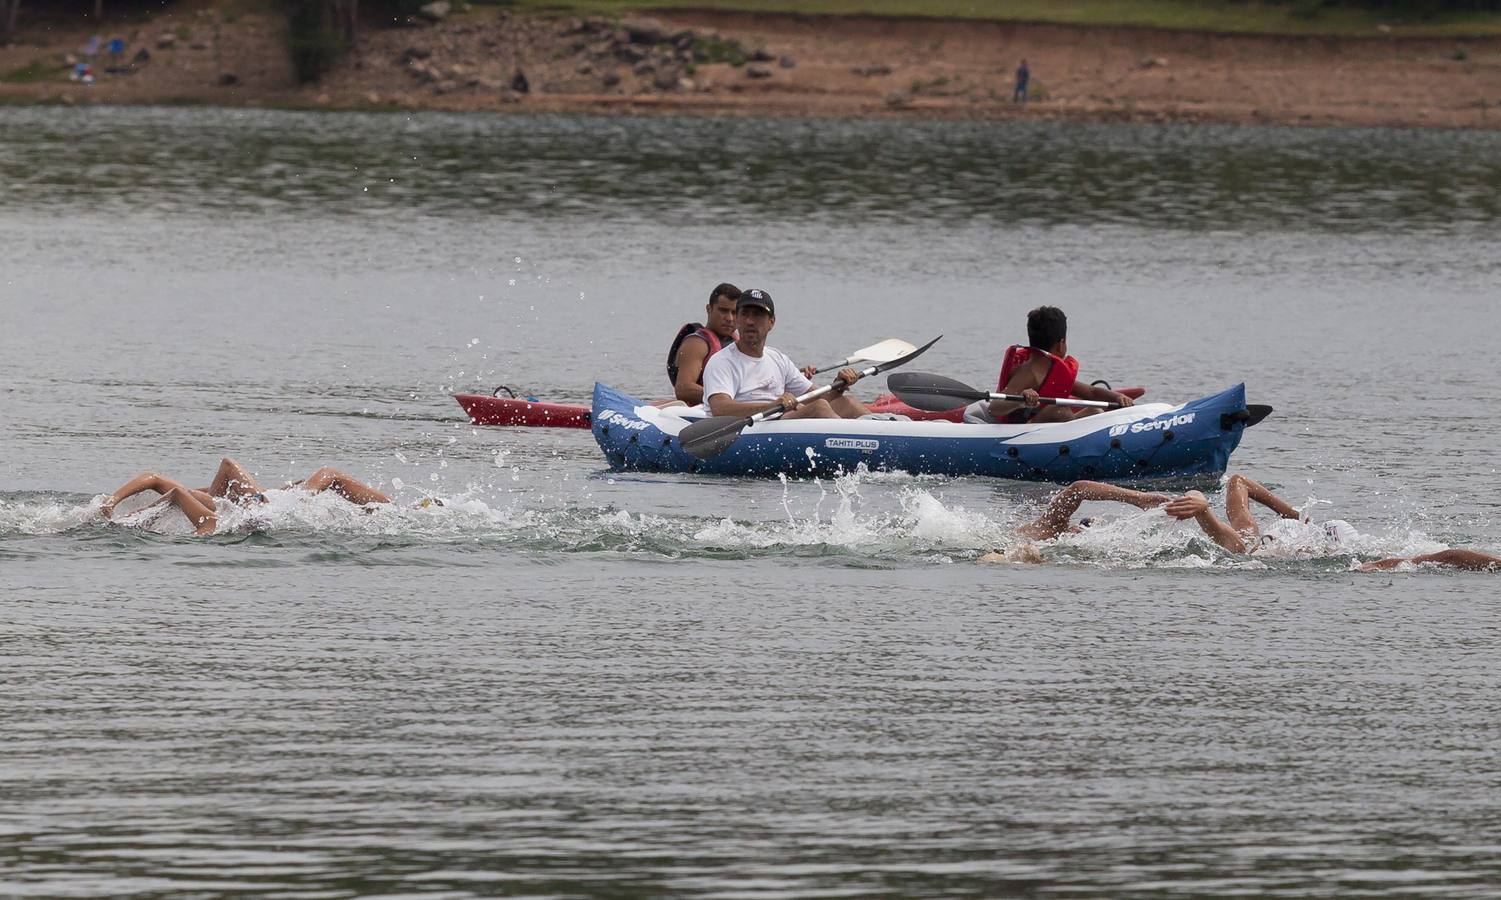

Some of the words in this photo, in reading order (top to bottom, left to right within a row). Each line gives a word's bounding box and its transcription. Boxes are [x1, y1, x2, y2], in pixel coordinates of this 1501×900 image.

[1130, 413, 1196, 433] Sevylor
[828, 439, 854, 448] TAHITI
[855, 440, 877, 449] PLUS
